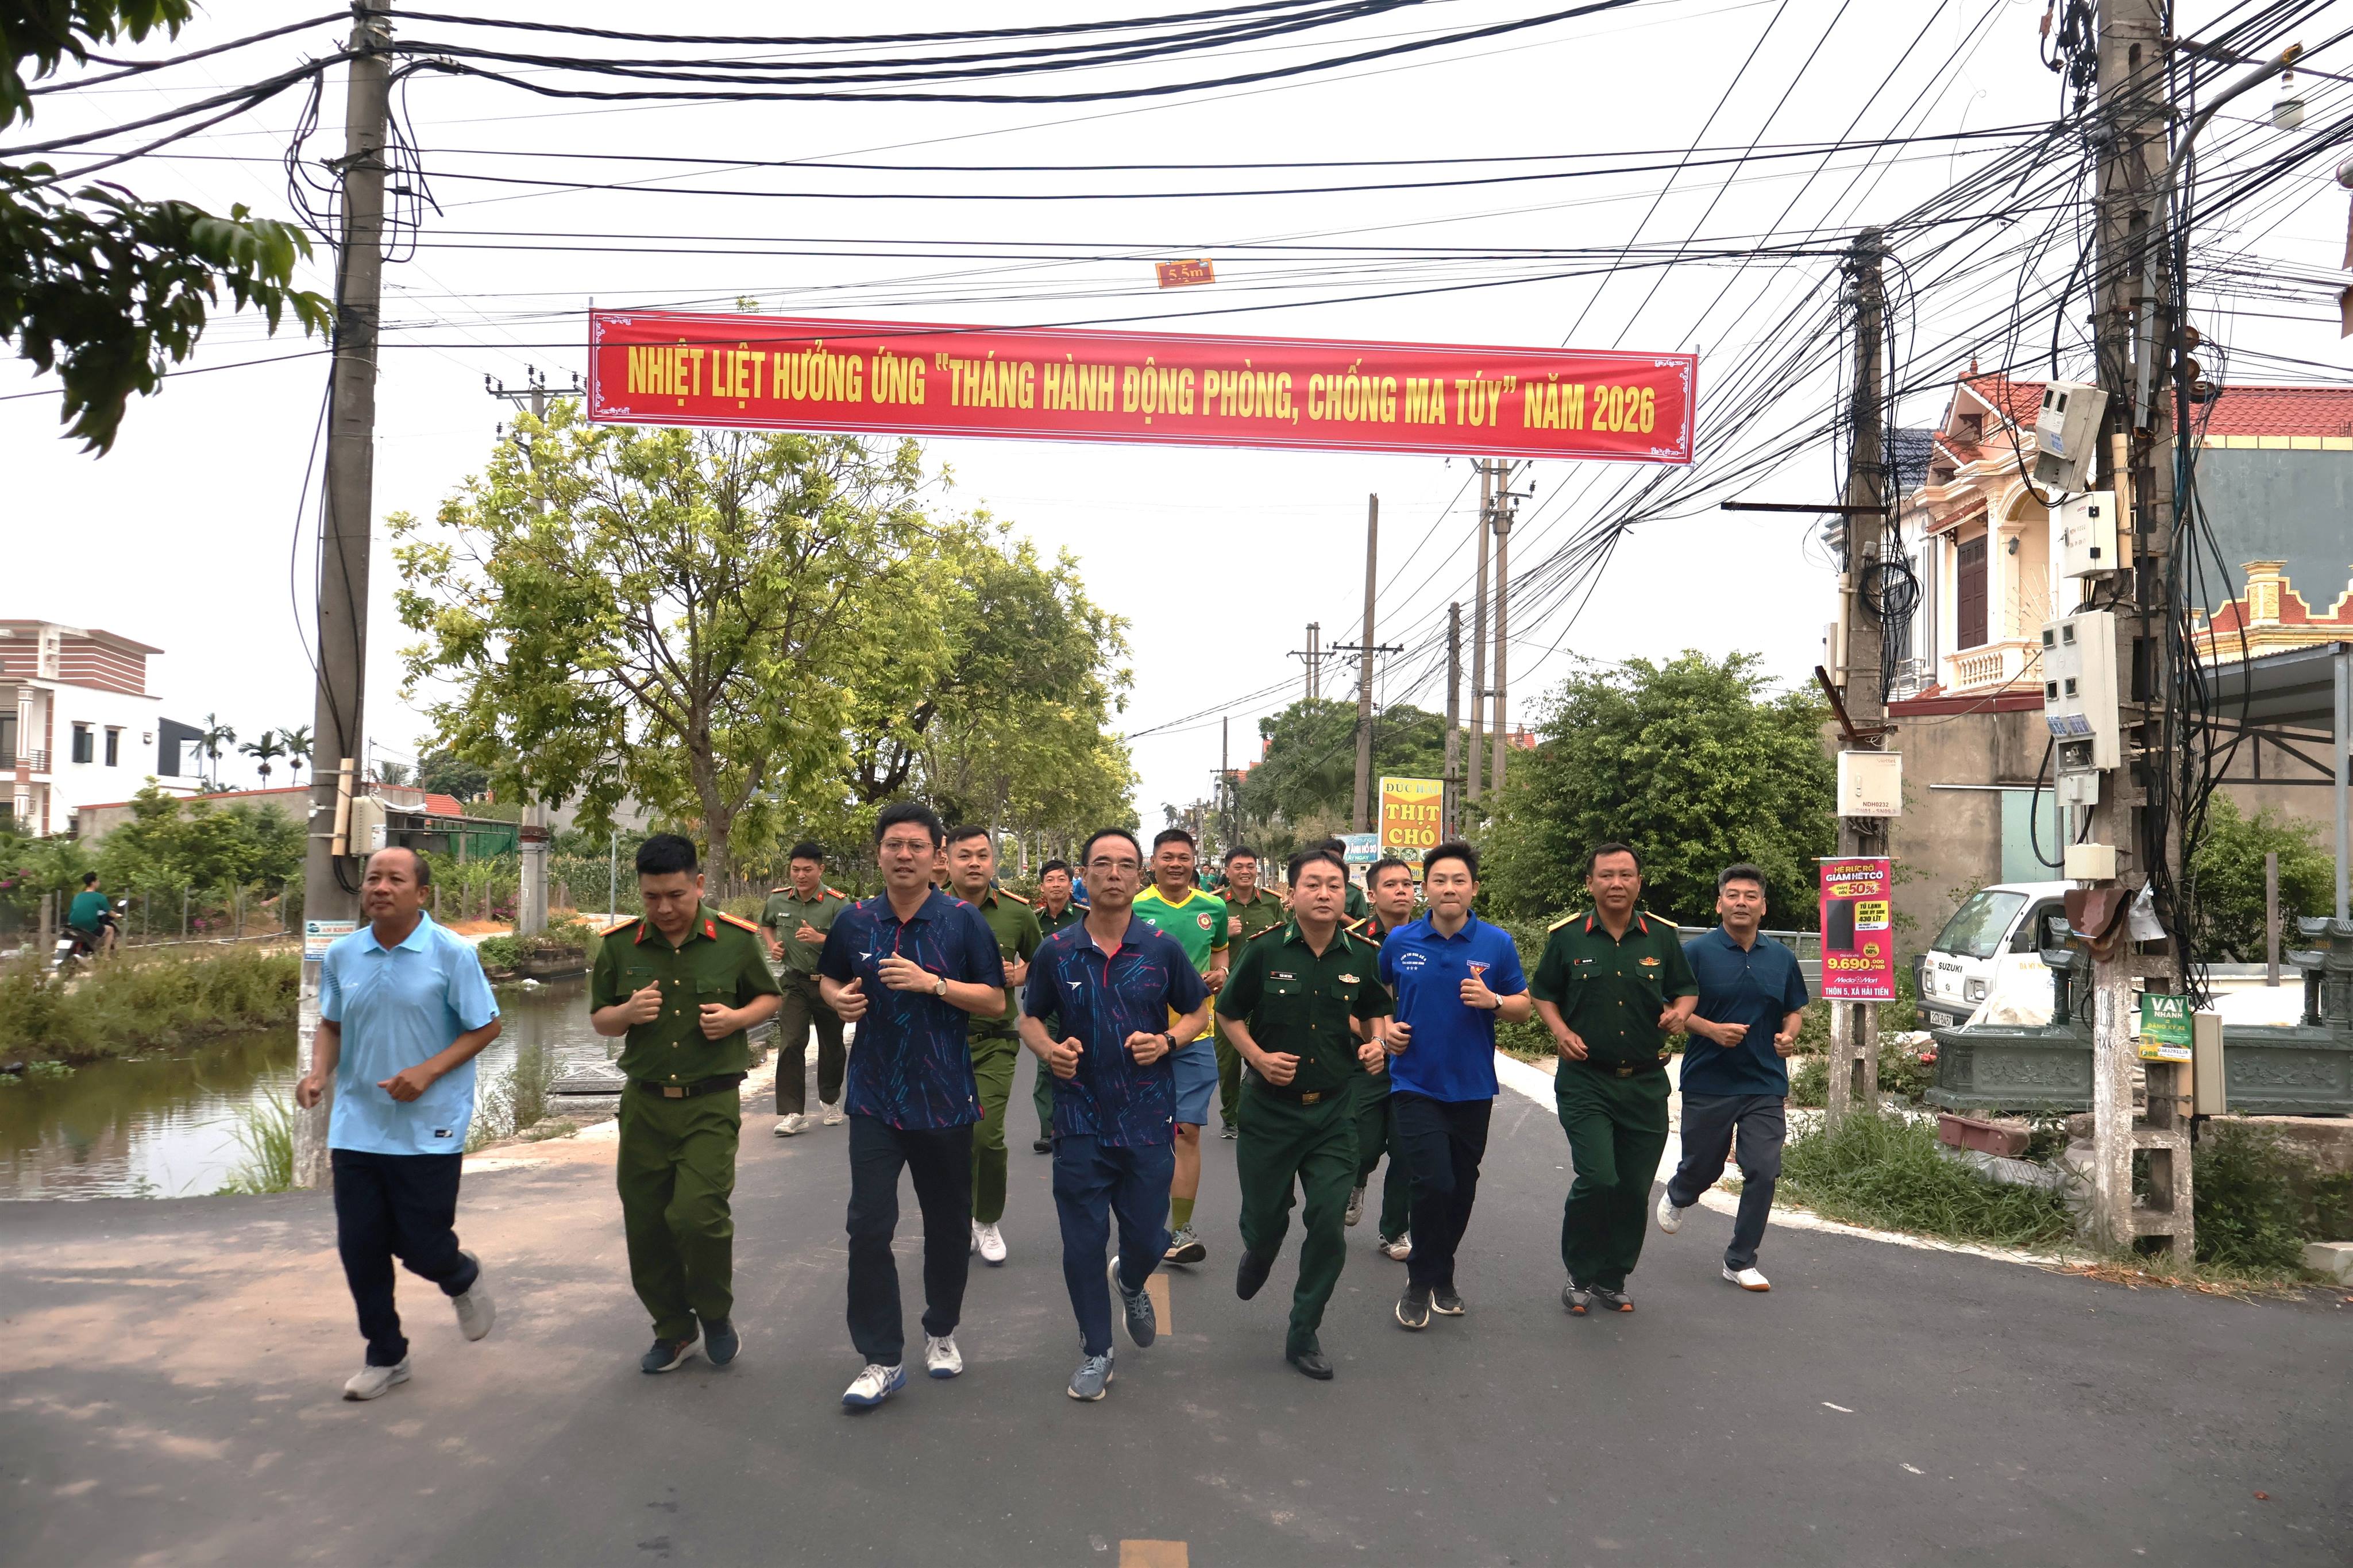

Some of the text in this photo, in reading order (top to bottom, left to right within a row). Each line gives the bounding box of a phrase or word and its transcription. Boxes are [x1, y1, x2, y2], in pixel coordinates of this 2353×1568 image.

[1168, 268, 1203, 281] 5.5m
[628, 338, 704, 405] NHIỆT
[712, 342, 766, 409] LIỆT
[773, 339, 863, 403] HƯỞNG
[871, 346, 925, 405] ỨNG
[1043, 353, 1115, 412] HÀNH
[1123, 357, 1195, 425] ĐỘNG
[1203, 358, 1299, 426] PHÒNG,
[1308, 358, 1398, 424] CHỐNG
[1405, 378, 1446, 425] MA
[1524, 373, 1585, 431] NĂM
[1592, 385, 1656, 434] 2026
[1386, 781, 1412, 793] ĐỨC
[1385, 804, 1440, 825] THỊT
[1388, 825, 1435, 845] CHÓ
[1851, 871, 1867, 880] HẾT
[1849, 883, 1875, 894] 50%
[1827, 957, 1870, 970] 9.690
[1938, 962, 1963, 973] SUZUKI
[1825, 986, 1889, 996] THÔN 5, XÃ HẢI TIẾN
[2151, 997, 2184, 1013] VAY
